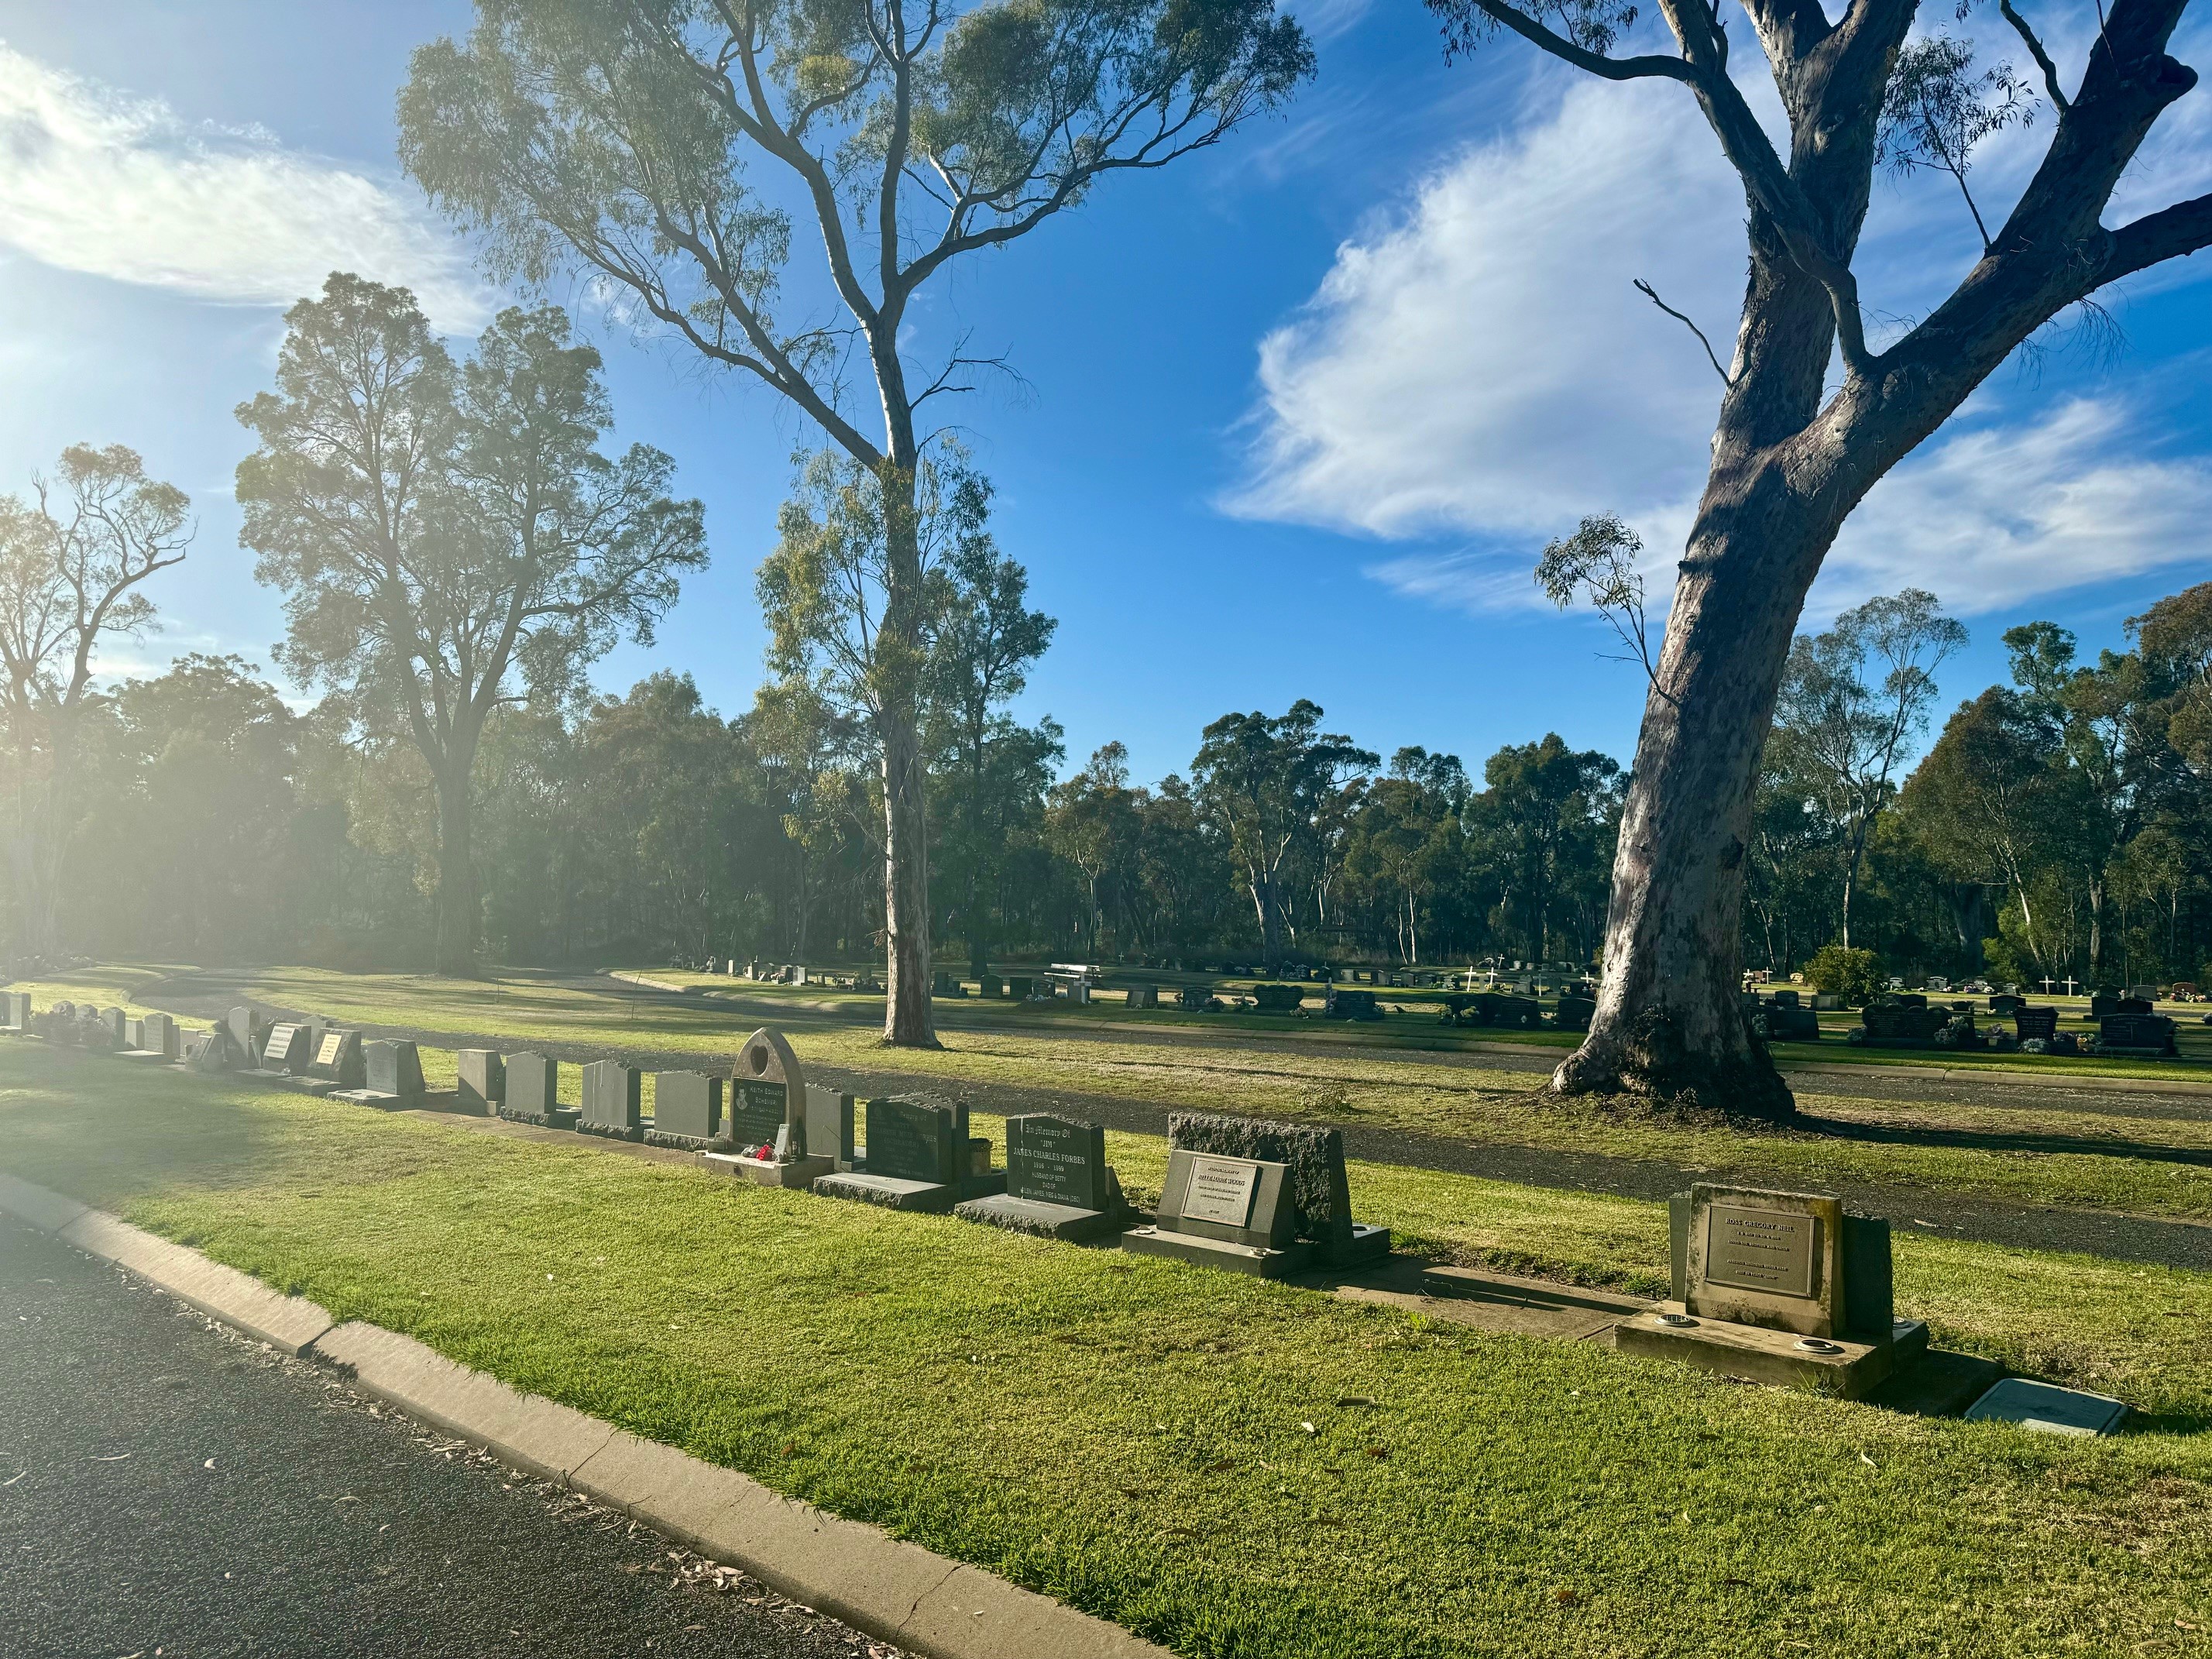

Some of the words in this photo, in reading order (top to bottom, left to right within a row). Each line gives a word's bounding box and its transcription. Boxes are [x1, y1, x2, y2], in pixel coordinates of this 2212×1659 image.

[764, 1087, 783, 1097] EDWARD
[1025, 1124, 1034, 1133] In
[1034, 1125, 1060, 1139] Memory
[1013, 1147, 1032, 1157] JAMES
[1033, 1150, 1060, 1161] CHARLES
[1061, 1154, 1085, 1165] FORBES
[1032, 1171, 1049, 1180] HUSBAND
[1725, 1218, 1743, 1226] ROSS
[1743, 1221, 1776, 1230] GREGORY
[1778, 1224, 1795, 1233] NEIL
